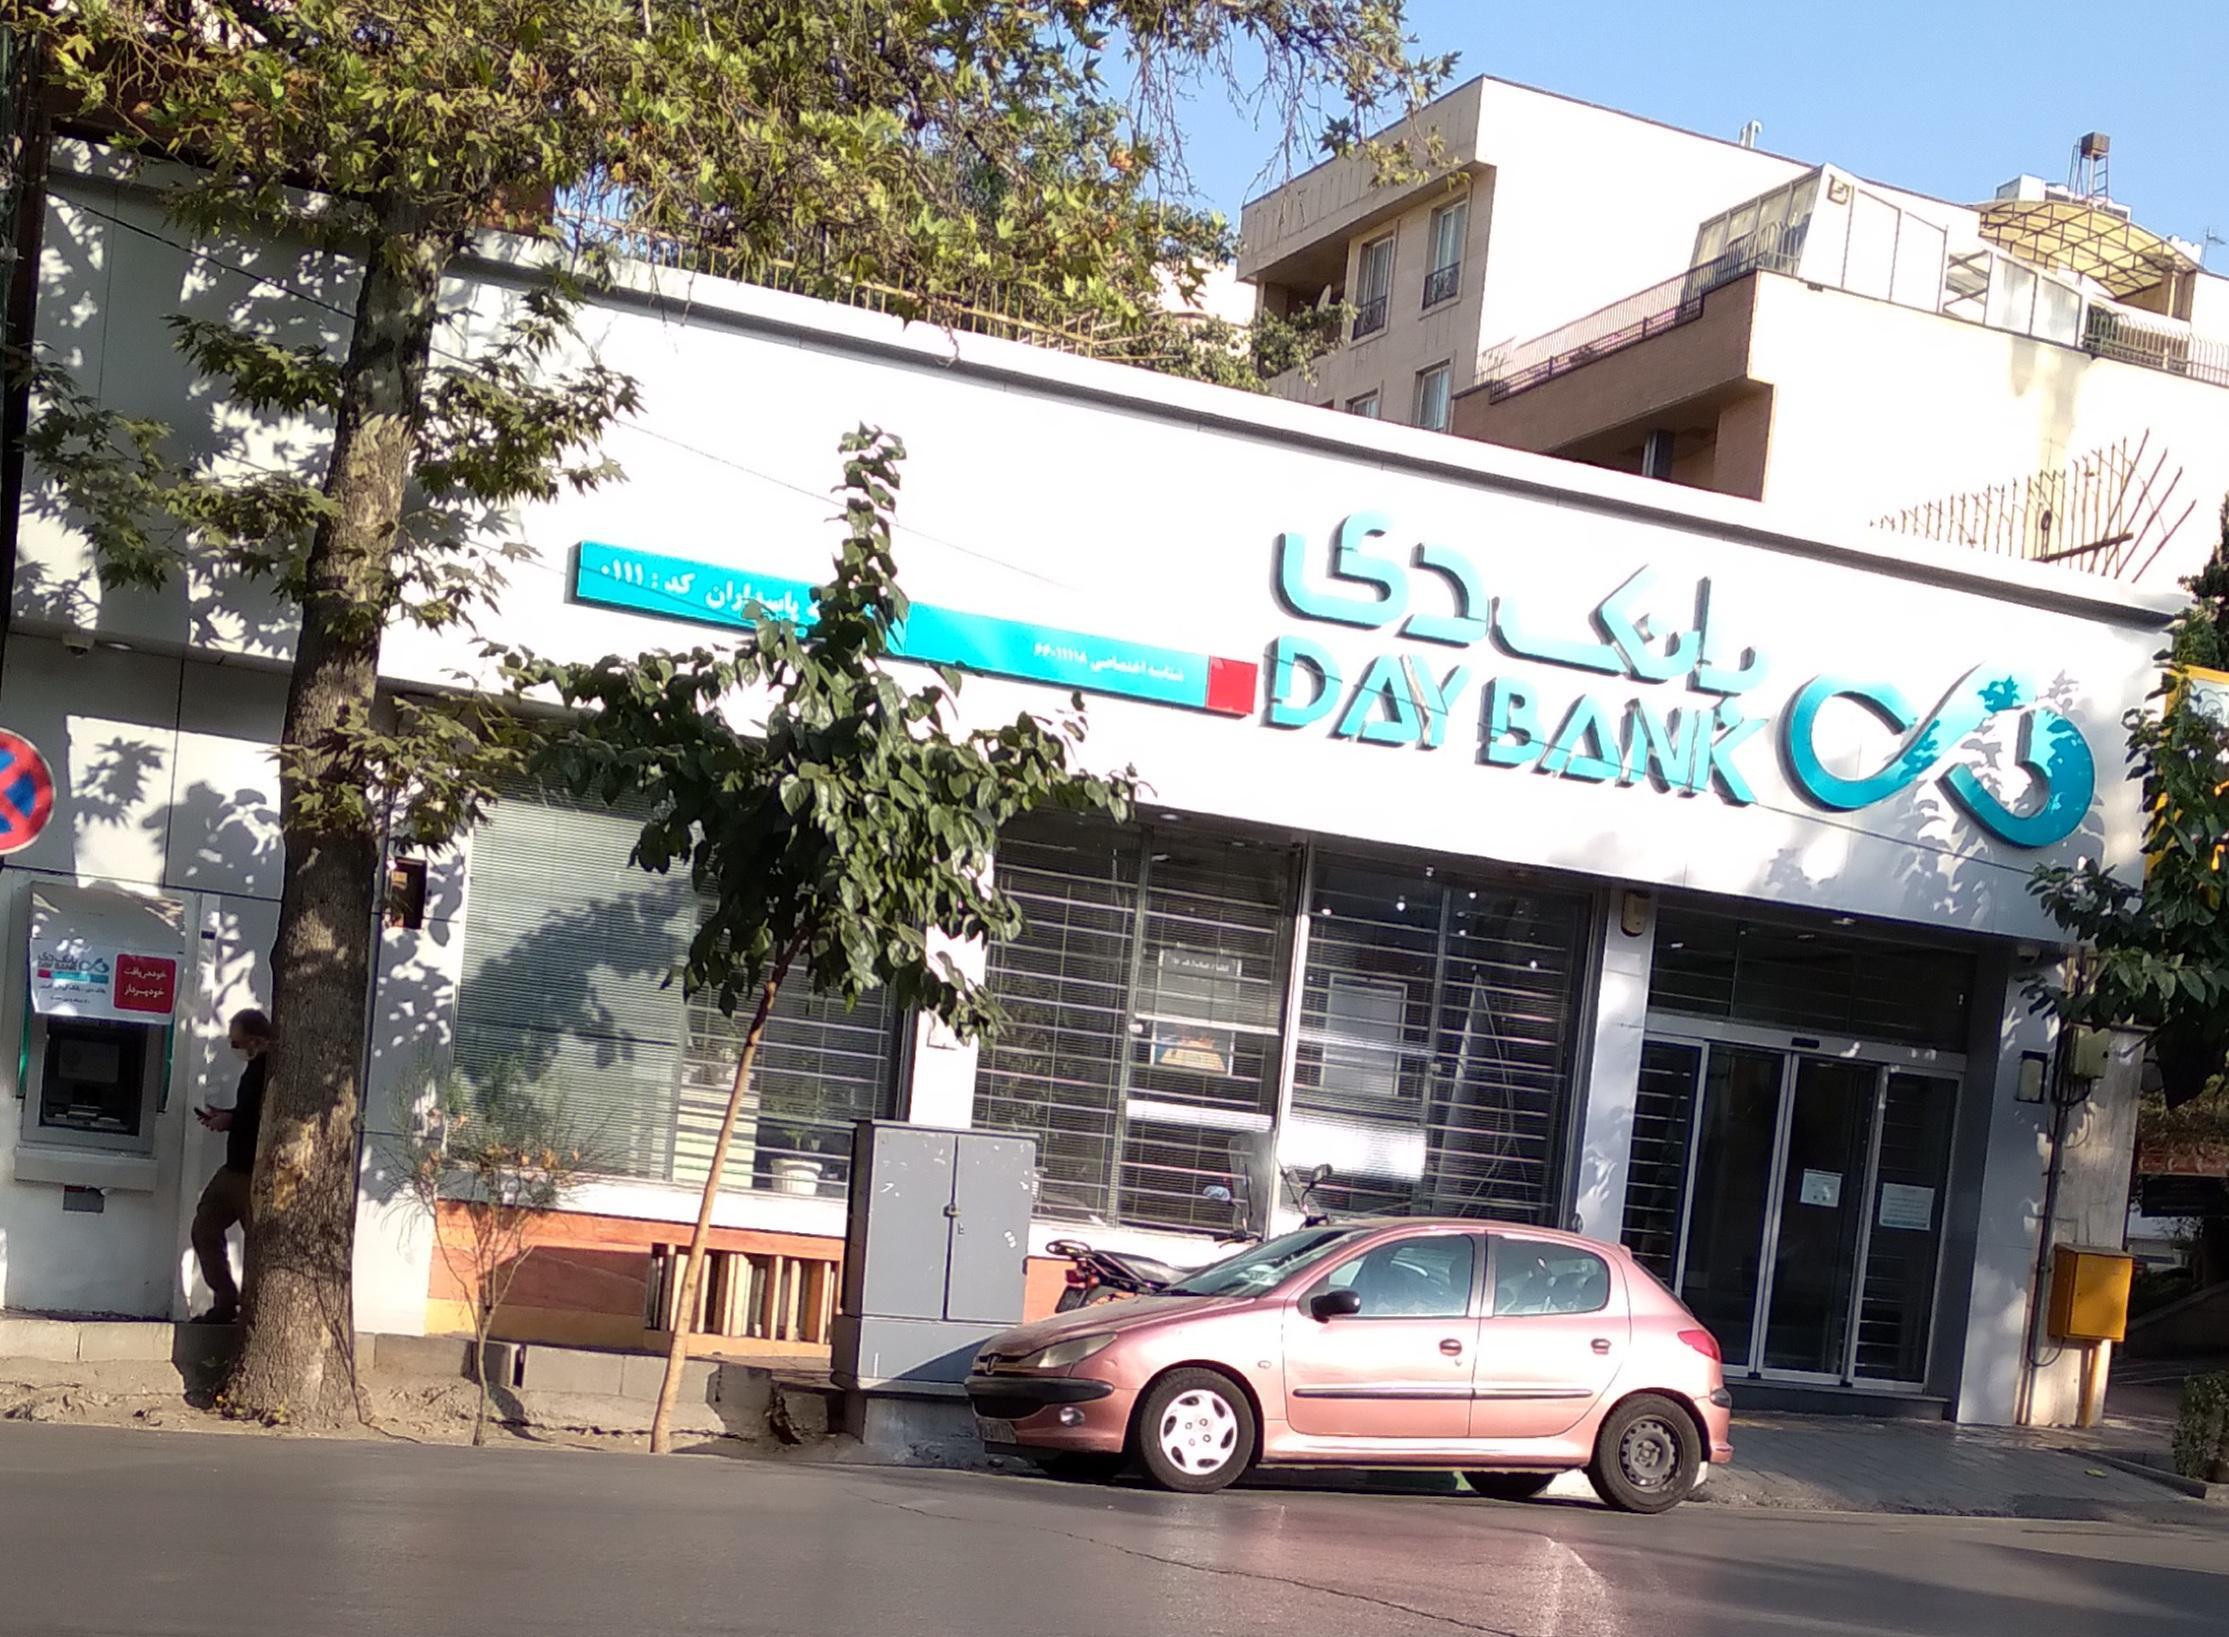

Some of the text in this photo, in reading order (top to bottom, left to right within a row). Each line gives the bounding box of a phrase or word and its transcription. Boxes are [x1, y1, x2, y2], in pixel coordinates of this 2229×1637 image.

[600, 558, 644, 586] ۰۱۱۱
[1269, 509, 1770, 722] بانک دی
[1260, 635, 1770, 808] DAY BANK
